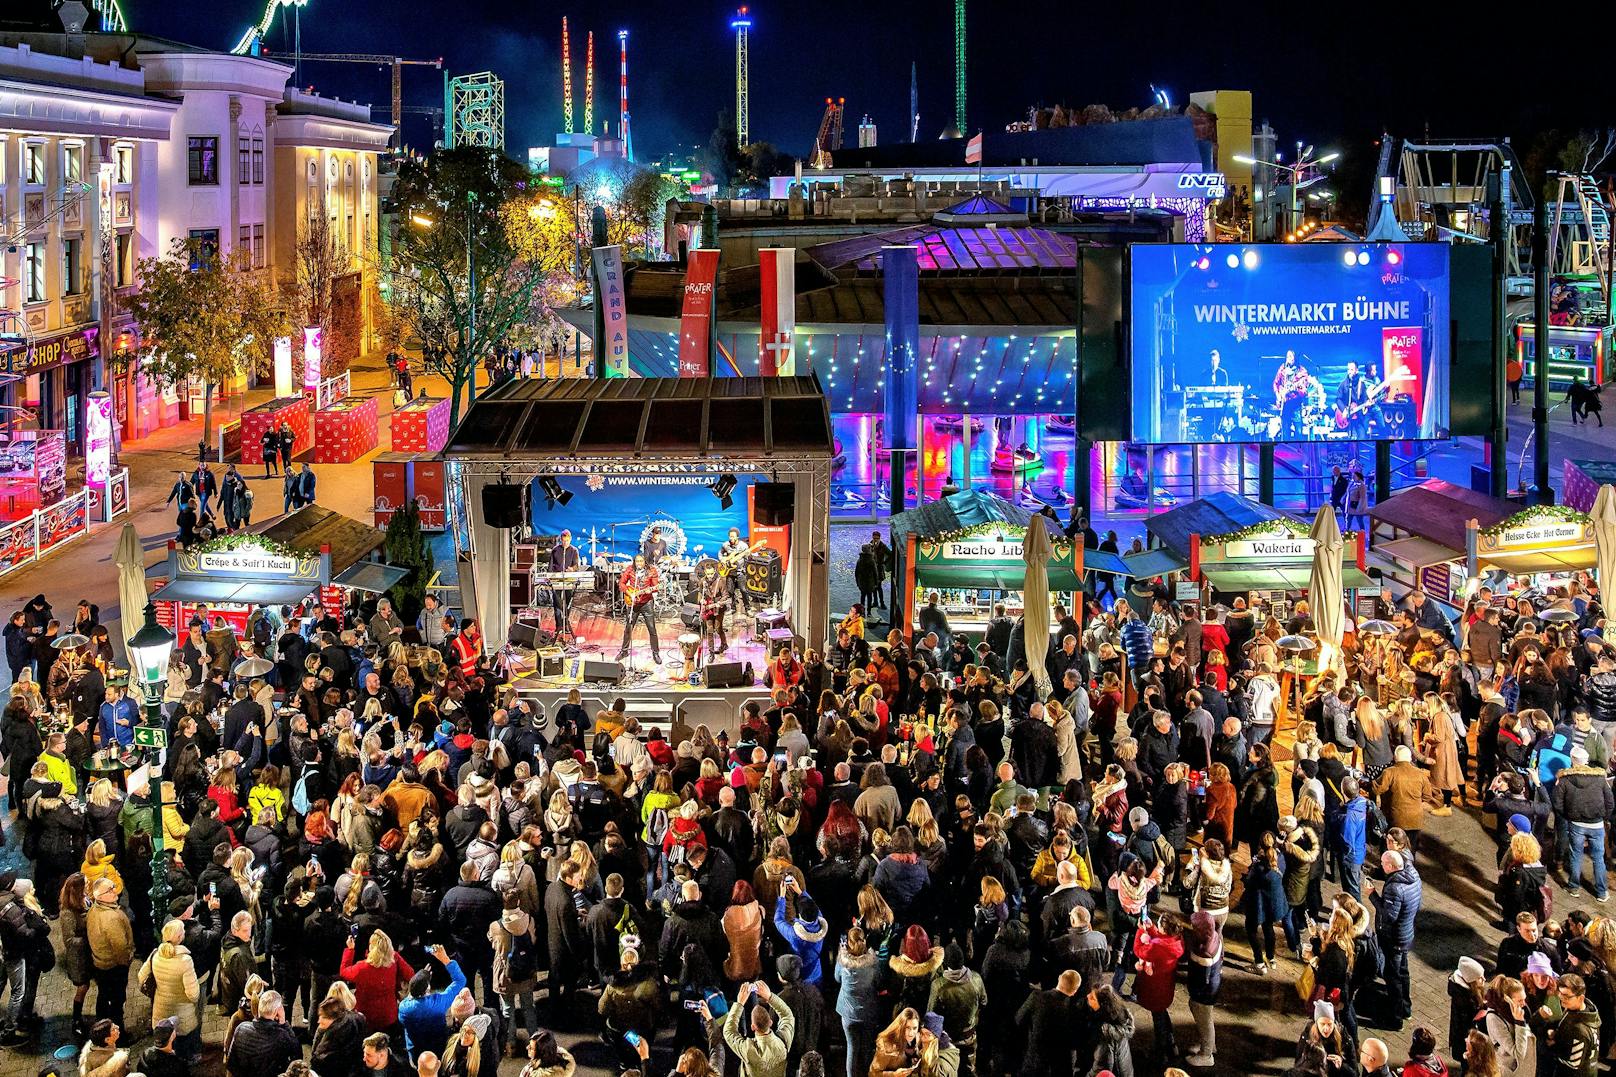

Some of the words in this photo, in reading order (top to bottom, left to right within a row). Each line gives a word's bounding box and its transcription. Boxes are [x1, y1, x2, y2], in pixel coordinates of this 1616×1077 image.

[603, 258, 622, 321] GRAND
[685, 282, 712, 294] PRATER
[1194, 303, 1337, 323] WINTERMARKT
[1342, 296, 1410, 321] BÜHNE
[1252, 324, 1352, 336] WWW.WINTERMARKT.AT
[1387, 335, 1417, 348] PRATER
[31, 342, 61, 367] SHOP
[613, 332, 625, 378] AUT
[607, 477, 716, 486] WWW.WINTERMARKT.AT
[951, 544, 996, 555] Nacho
[1252, 542, 1302, 554] Wakeria
[232, 558, 240, 567] &
